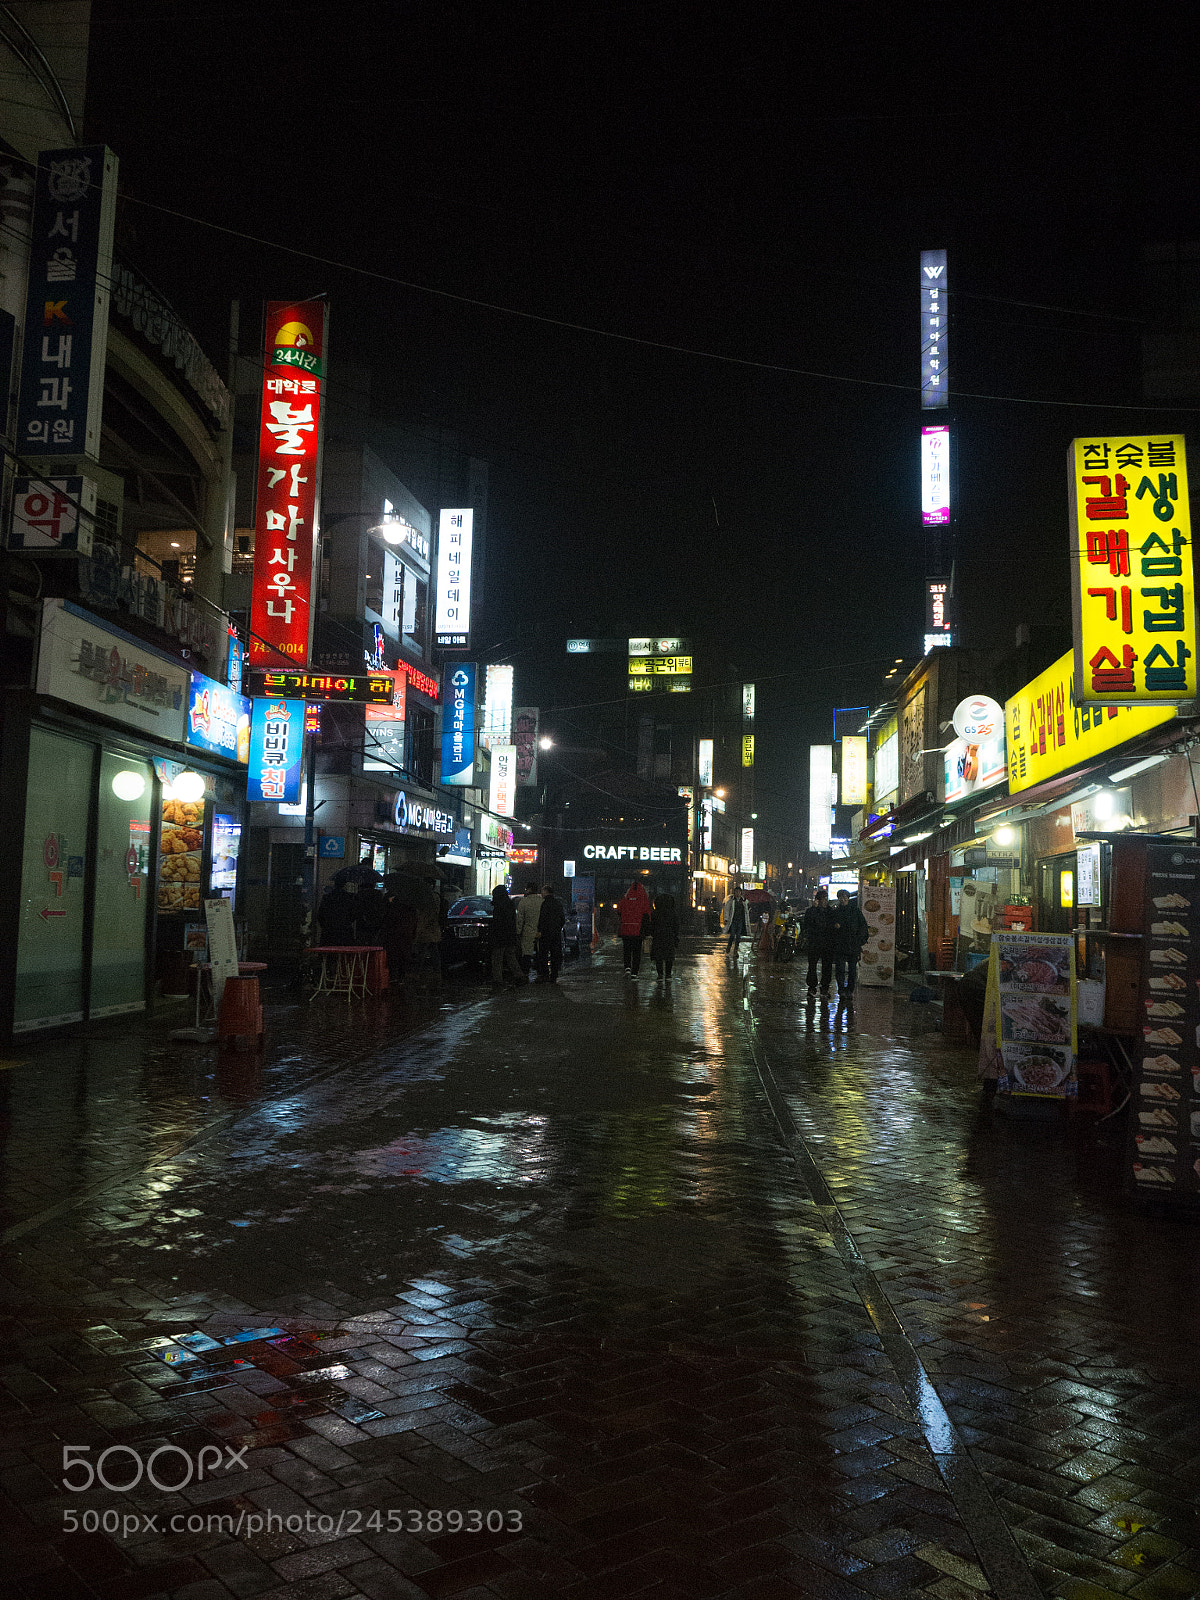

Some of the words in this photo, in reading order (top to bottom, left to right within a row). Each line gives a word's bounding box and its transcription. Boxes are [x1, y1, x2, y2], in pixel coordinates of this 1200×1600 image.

[276, 349, 318, 370] 24시간
[266, 379, 318, 395] 대학로
[26, 418, 74, 443] 의원
[1083, 440, 1177, 470] 참숯불
[23, 492, 69, 538] 약
[447, 514, 463, 621] 해피네일데이
[1135, 472, 1192, 692] 생삼겹살
[1082, 473, 1139, 693] 갈매기살
[369, 728, 394, 737] VINS
[1029, 680, 1065, 756] 소갈비살
[583, 845, 637, 860] CRAFT
[640, 846, 681, 861] BEER
